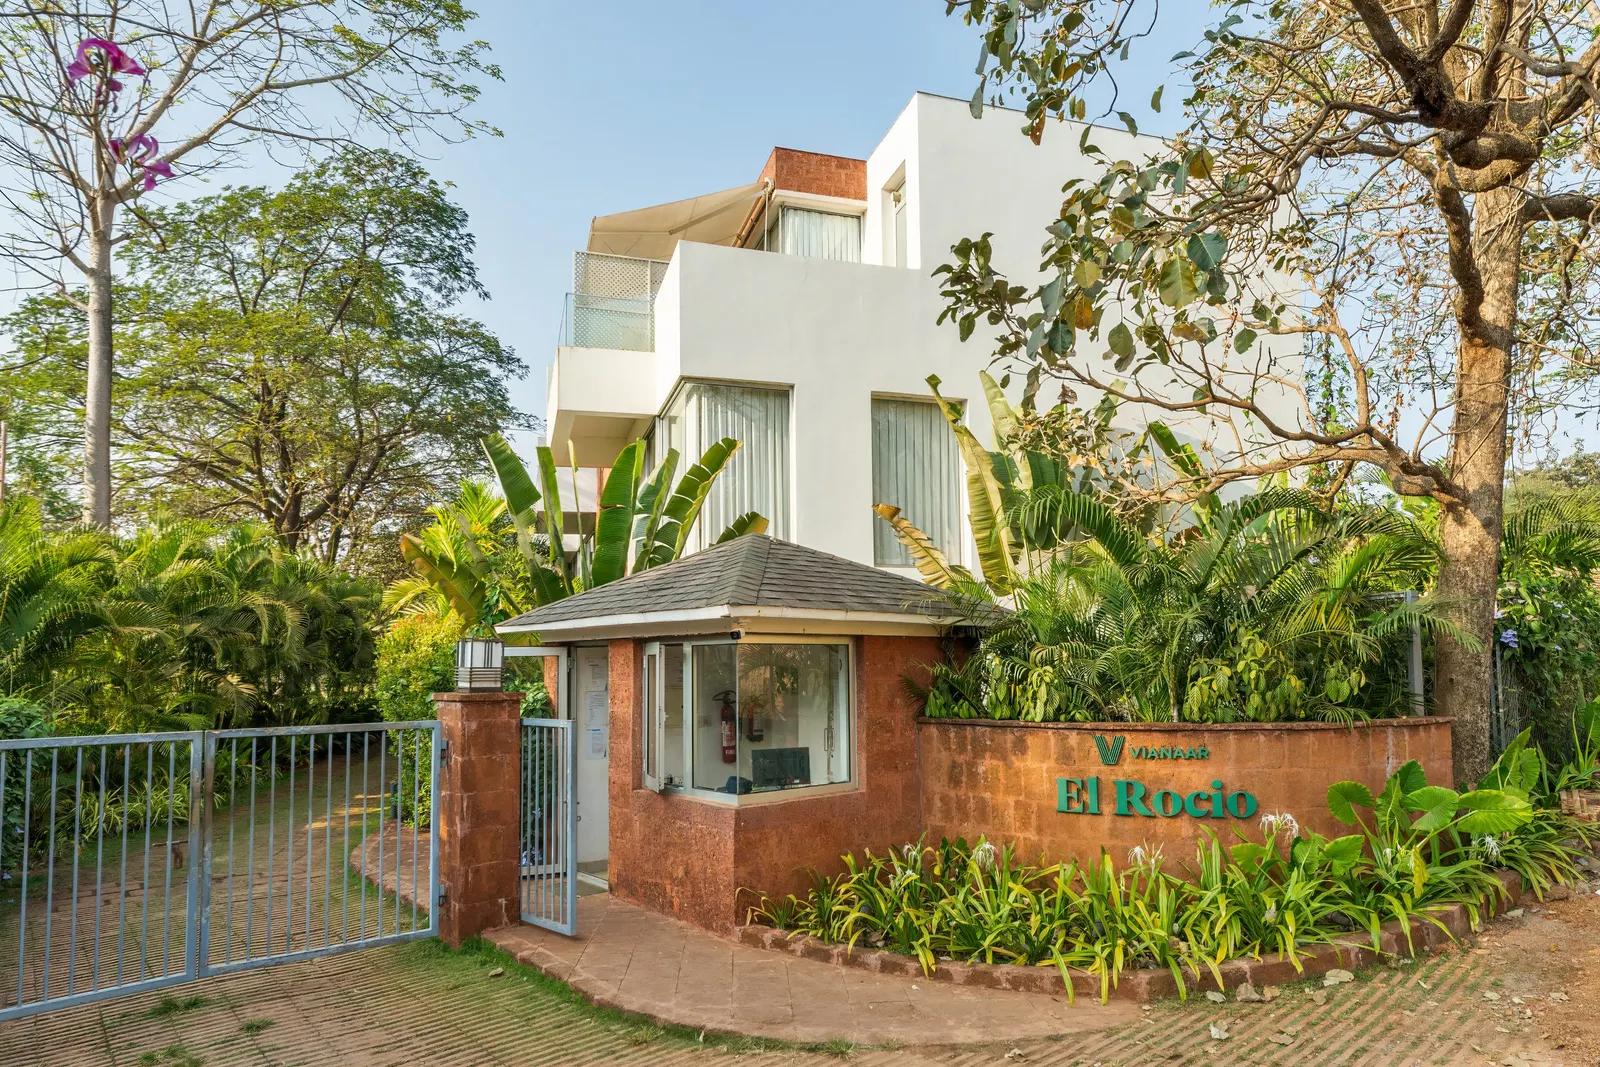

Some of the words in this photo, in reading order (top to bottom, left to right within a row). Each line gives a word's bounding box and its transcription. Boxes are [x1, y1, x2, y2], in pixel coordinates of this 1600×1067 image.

[1130, 746, 1210, 760] VIANAAR
[1055, 776, 1102, 815] El
[1112, 779, 1258, 819] Rocio
